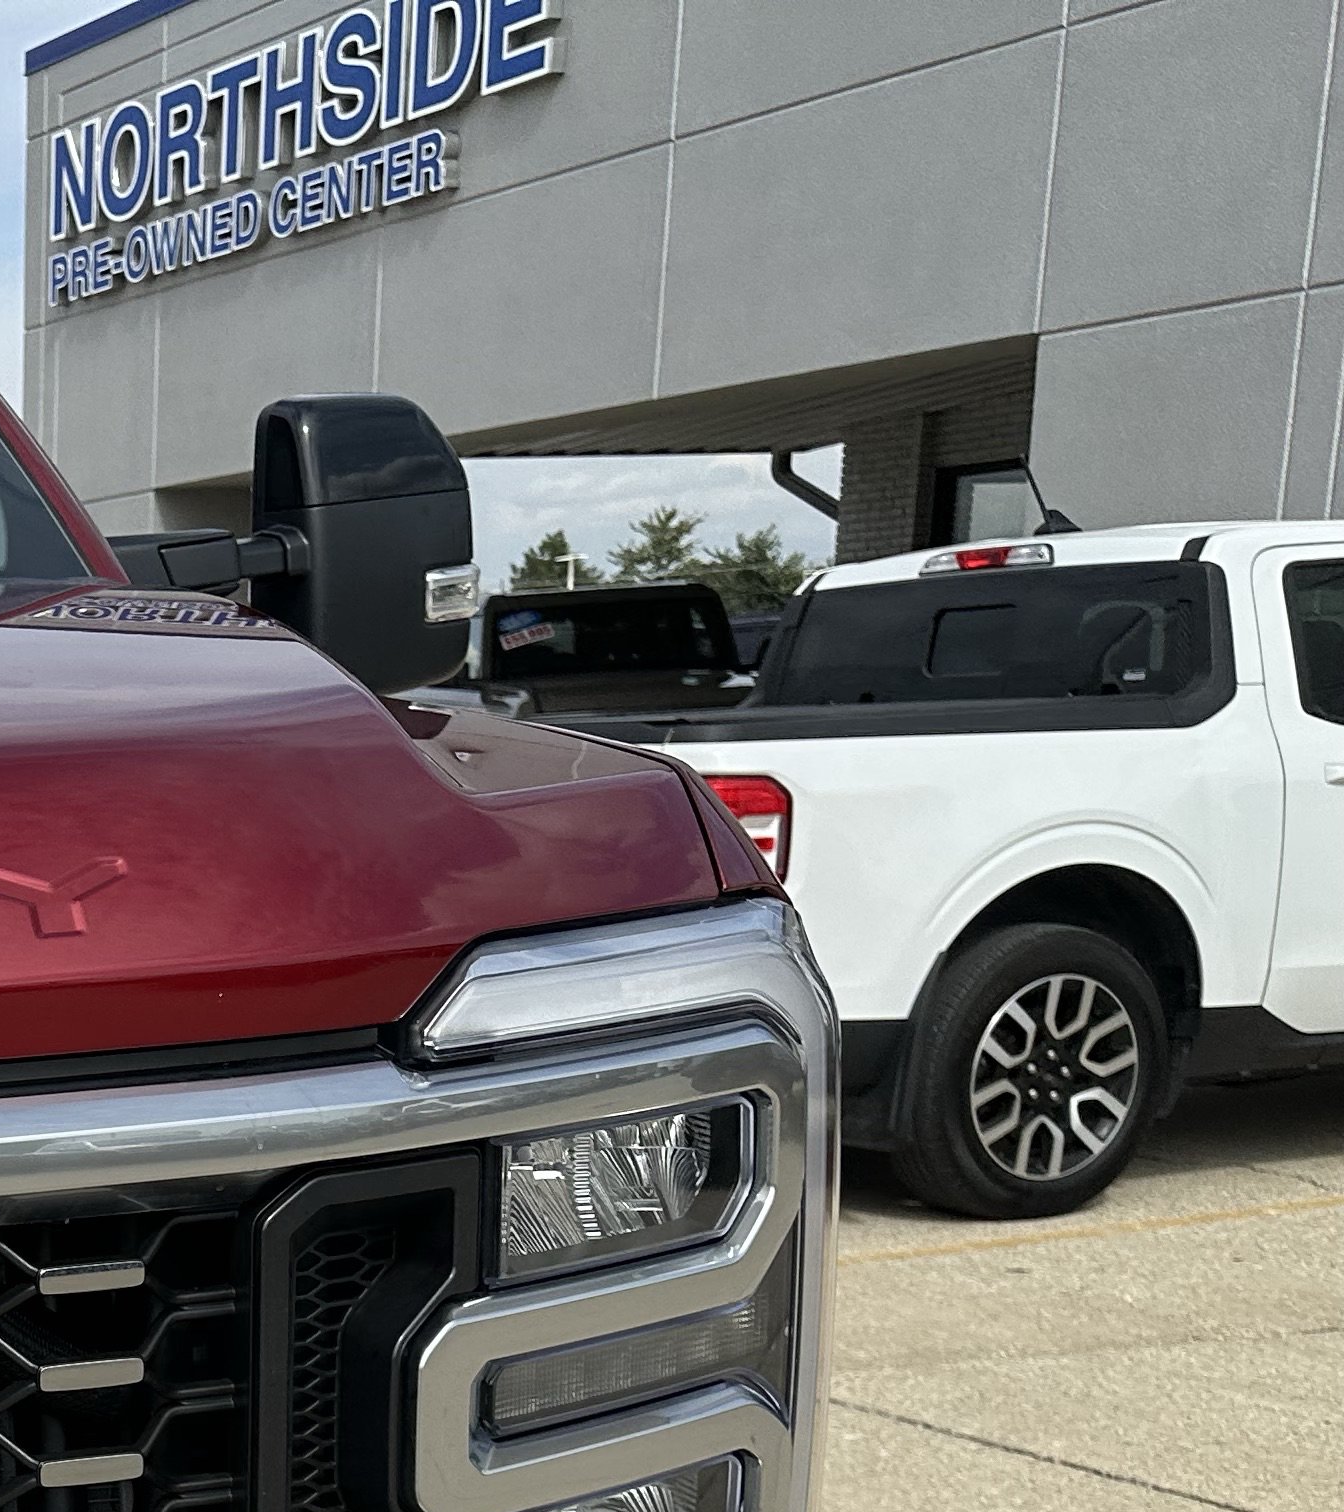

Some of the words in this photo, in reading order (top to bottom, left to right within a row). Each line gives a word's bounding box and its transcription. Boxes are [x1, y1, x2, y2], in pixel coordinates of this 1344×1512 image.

[48, 190, 262, 307] PRE-OWNED
[268, 128, 448, 239] CENTER
[49, 0, 555, 243] NORTHSIDE
